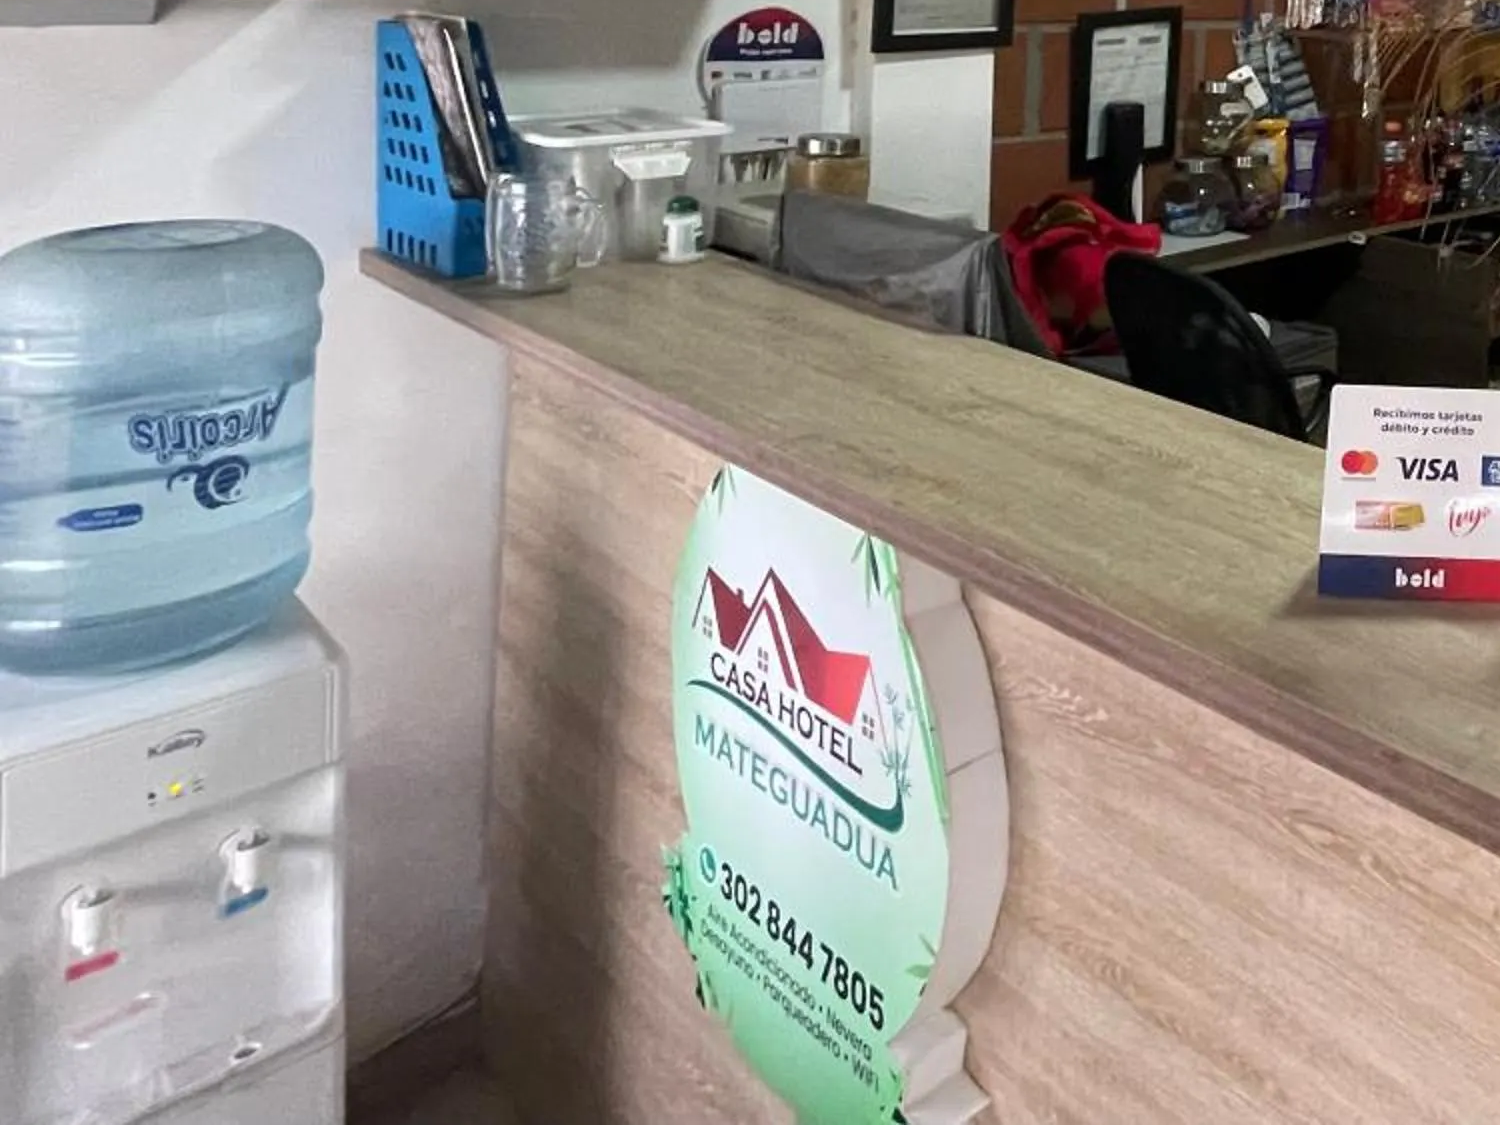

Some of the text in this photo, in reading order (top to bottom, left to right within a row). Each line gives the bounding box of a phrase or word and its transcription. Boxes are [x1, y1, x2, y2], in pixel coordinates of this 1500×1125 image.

[737, 22, 799, 45] bold
[129, 381, 290, 465] Arcoiris
[1373, 407, 1483, 423] Recibimos tarjetas
[1381, 423, 1475, 436] débito y crédito
[1396, 456, 1459, 482] VISA
[1395, 568, 1445, 588] bold
[710, 652, 863, 776] CASA HOTEL
[694, 713, 899, 892] MATEGUADUA
[700, 917, 755, 980] Desayuno
[762, 976, 841, 1059] Parqueadero
[720, 862, 885, 1032] 302 844 7805
[729, 922, 816, 1012] Acondicionado
[826, 1005, 873, 1061] Nevera
